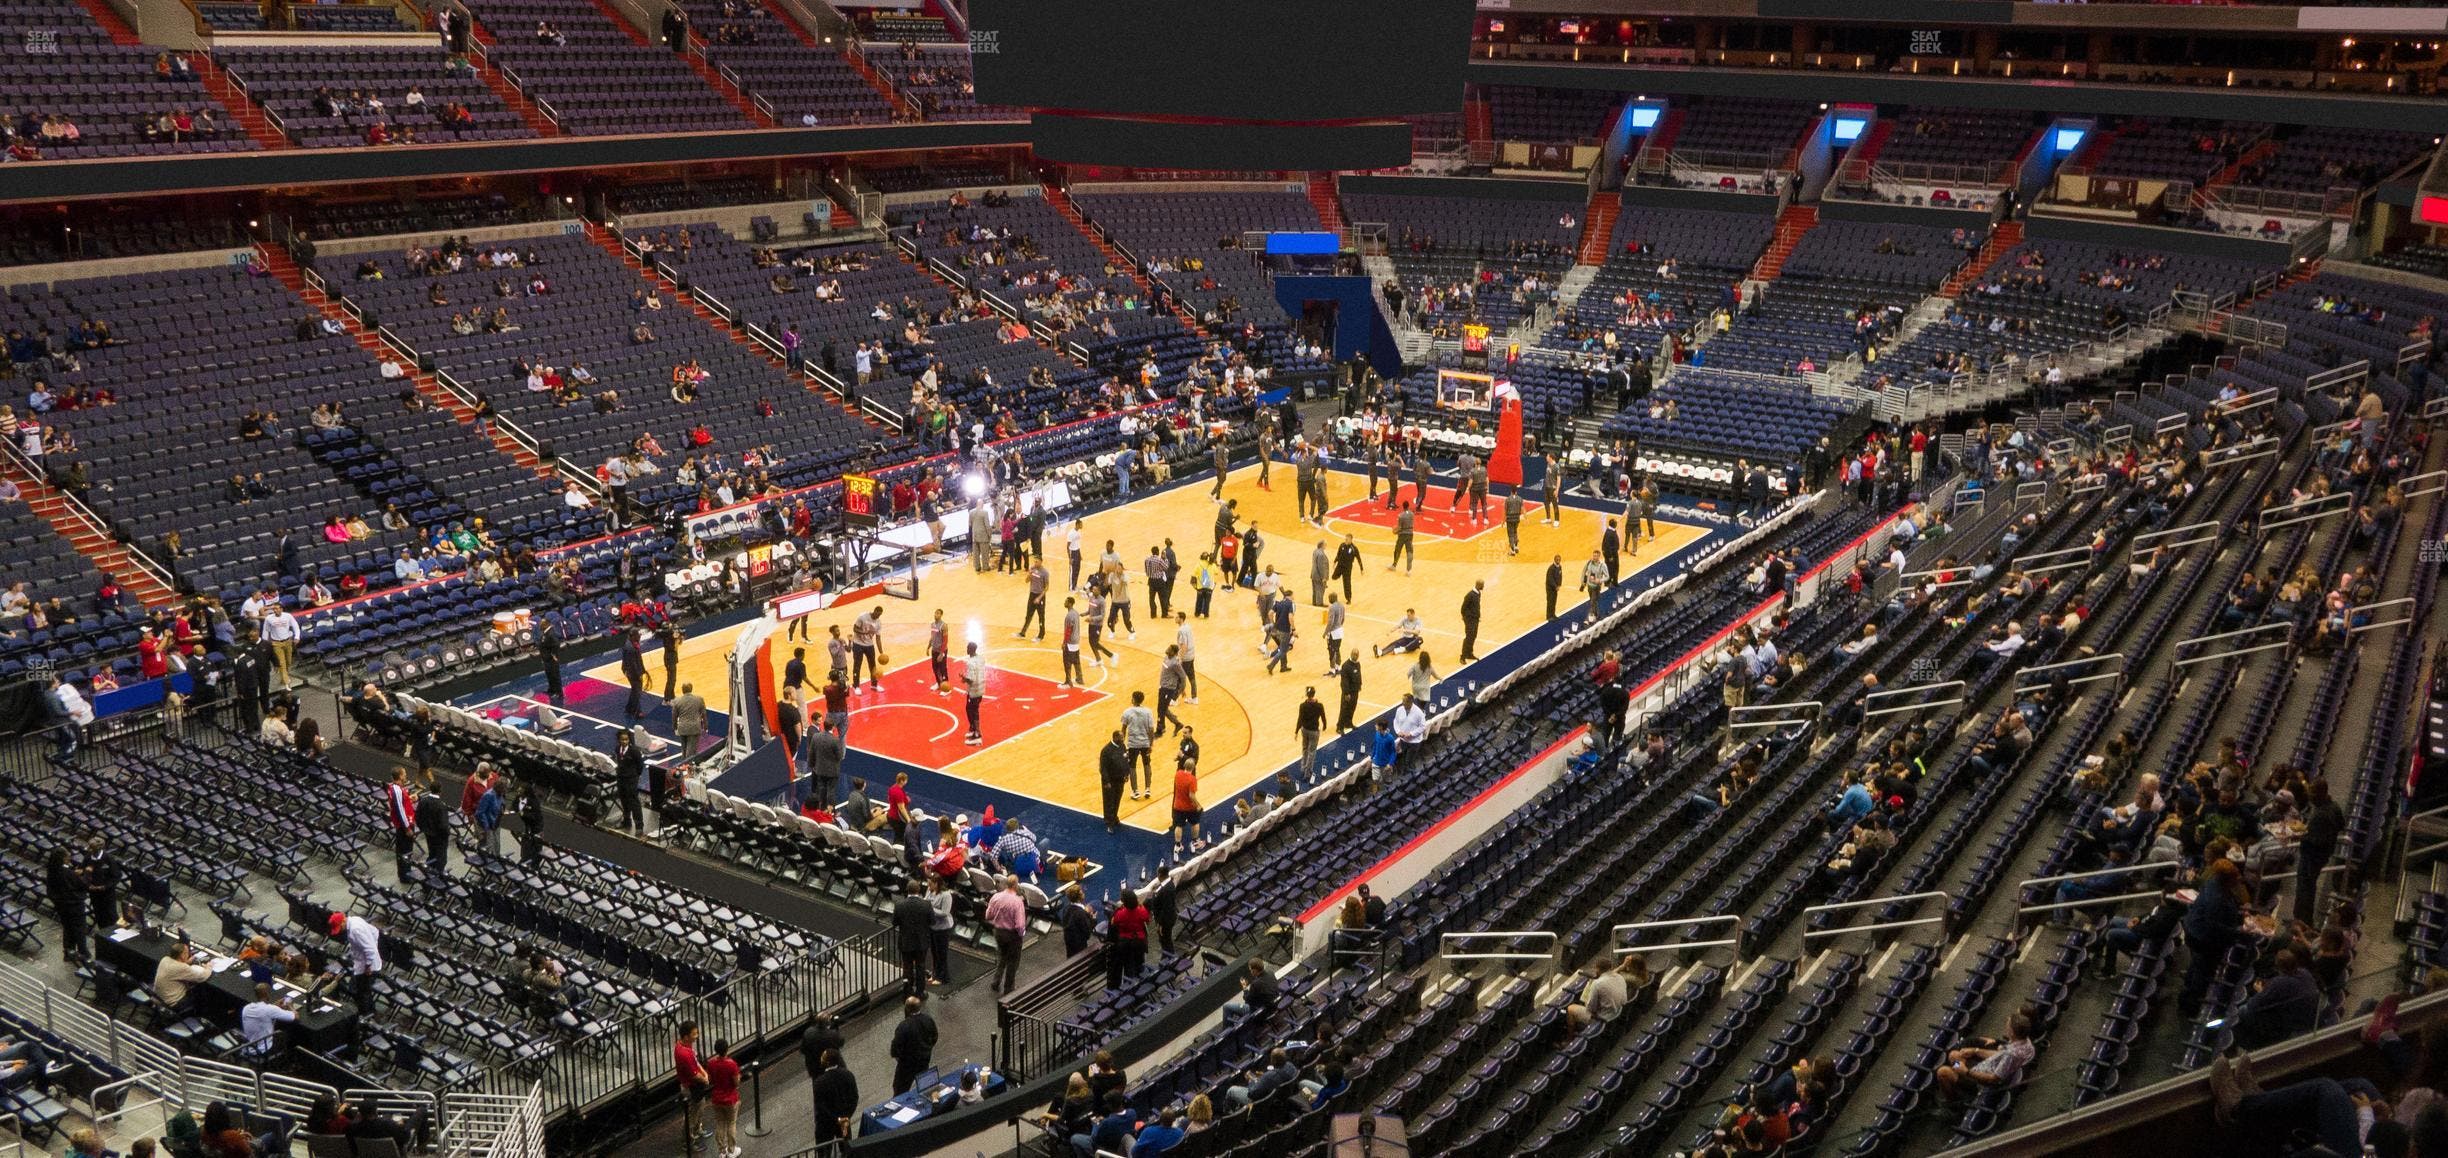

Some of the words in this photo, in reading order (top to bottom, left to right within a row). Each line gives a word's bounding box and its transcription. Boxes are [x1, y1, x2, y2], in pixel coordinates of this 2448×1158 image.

[817, 203, 828, 213] 121
[565, 224, 581, 234] 100
[850, 480, 872, 496] 12:32
